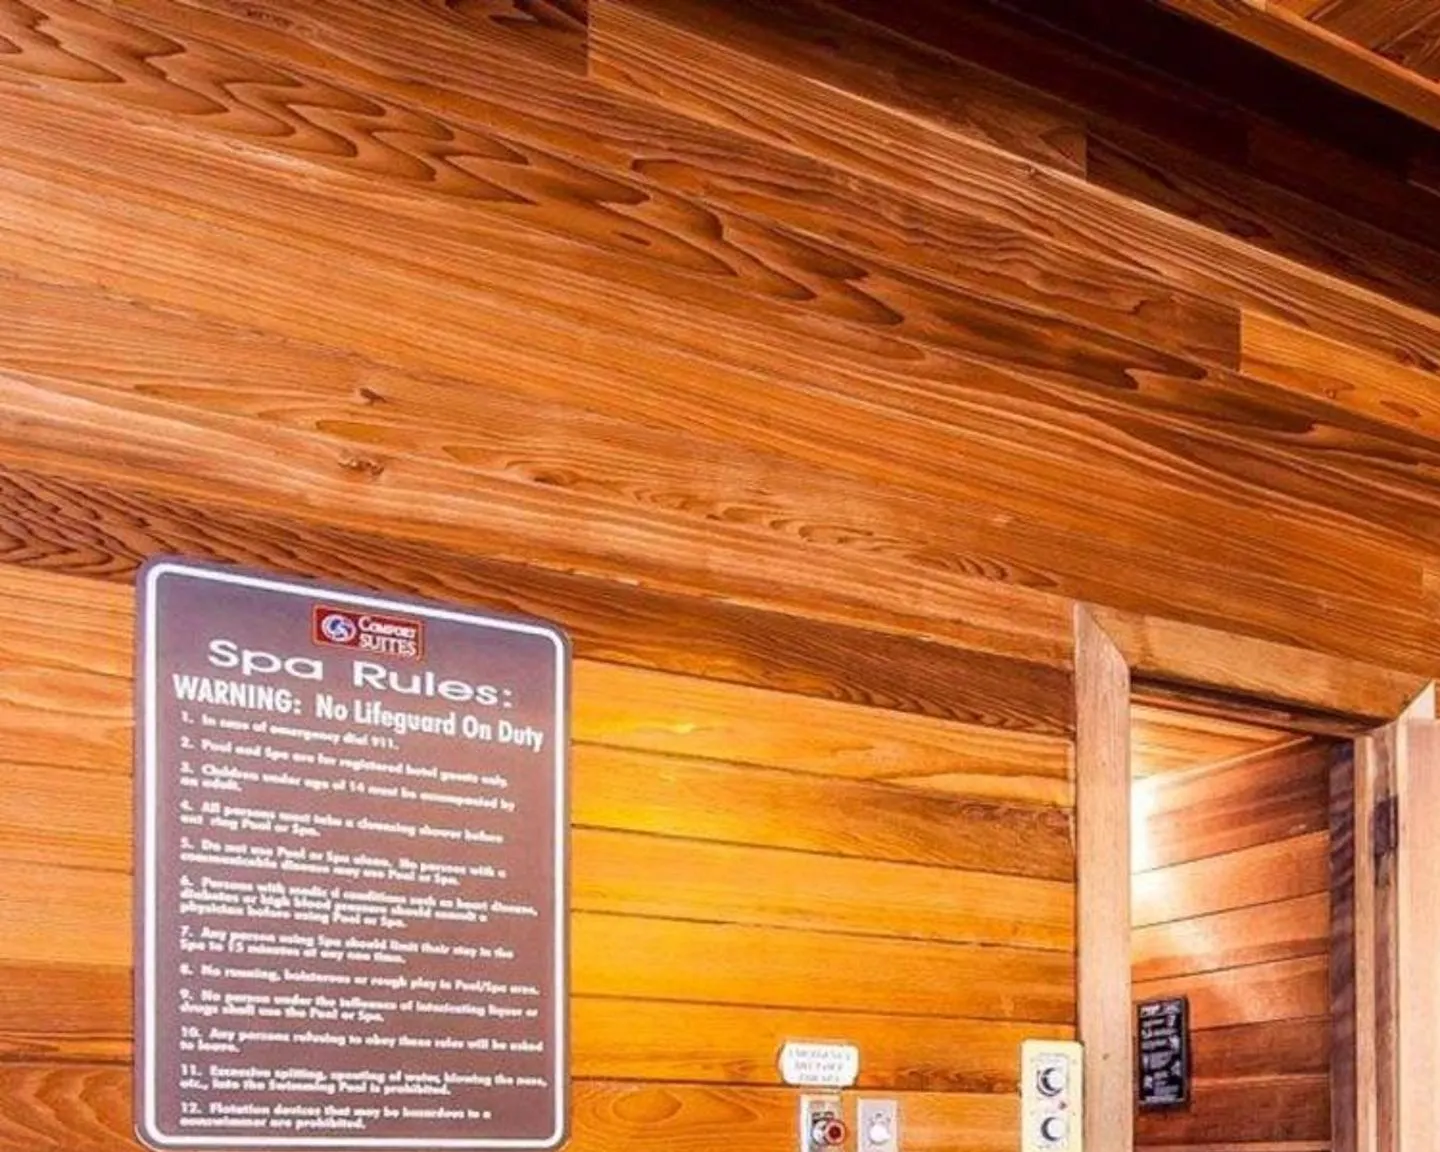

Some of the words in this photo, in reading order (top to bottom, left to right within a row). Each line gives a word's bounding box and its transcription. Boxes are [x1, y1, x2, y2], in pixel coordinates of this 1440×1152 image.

[208, 639, 324, 677] Spa
[353, 660, 514, 708] Rules:
[358, 632, 418, 657] SUITES
[172, 673, 302, 716] WARNING:
[316, 693, 348, 720] No
[354, 699, 455, 741] Lifeguard
[462, 715, 490, 741] On
[497, 719, 544, 753] Duty
